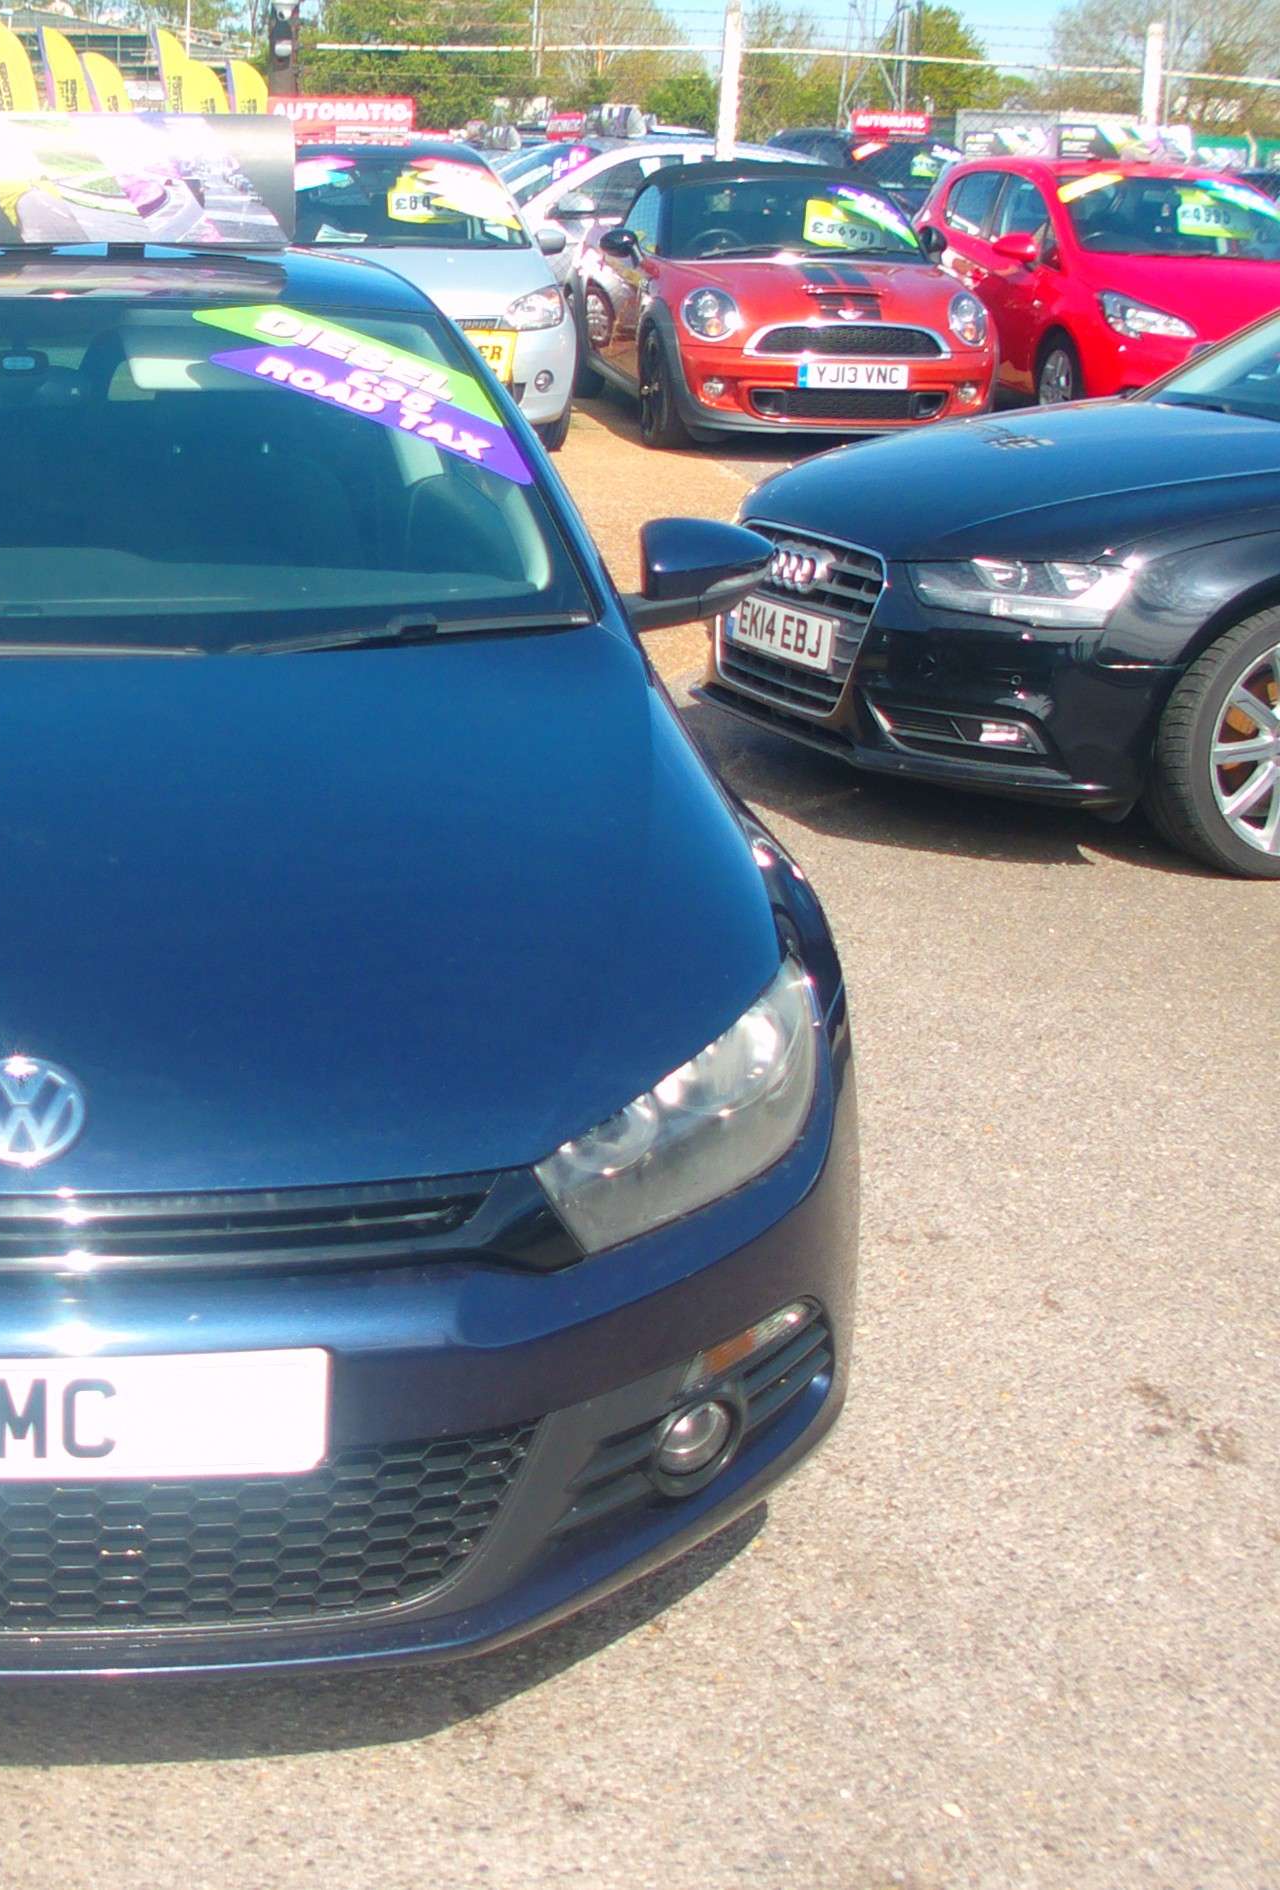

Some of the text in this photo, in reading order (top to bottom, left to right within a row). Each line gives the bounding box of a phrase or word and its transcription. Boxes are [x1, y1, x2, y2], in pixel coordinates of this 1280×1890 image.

[273, 102, 411, 121] AUTOMATIC
[255, 311, 453, 401] DIESEL
[817, 366, 900, 384] YJ13 VNC
[255, 356, 495, 461] ROAD TAX
[780, 614, 824, 659] EBJ
